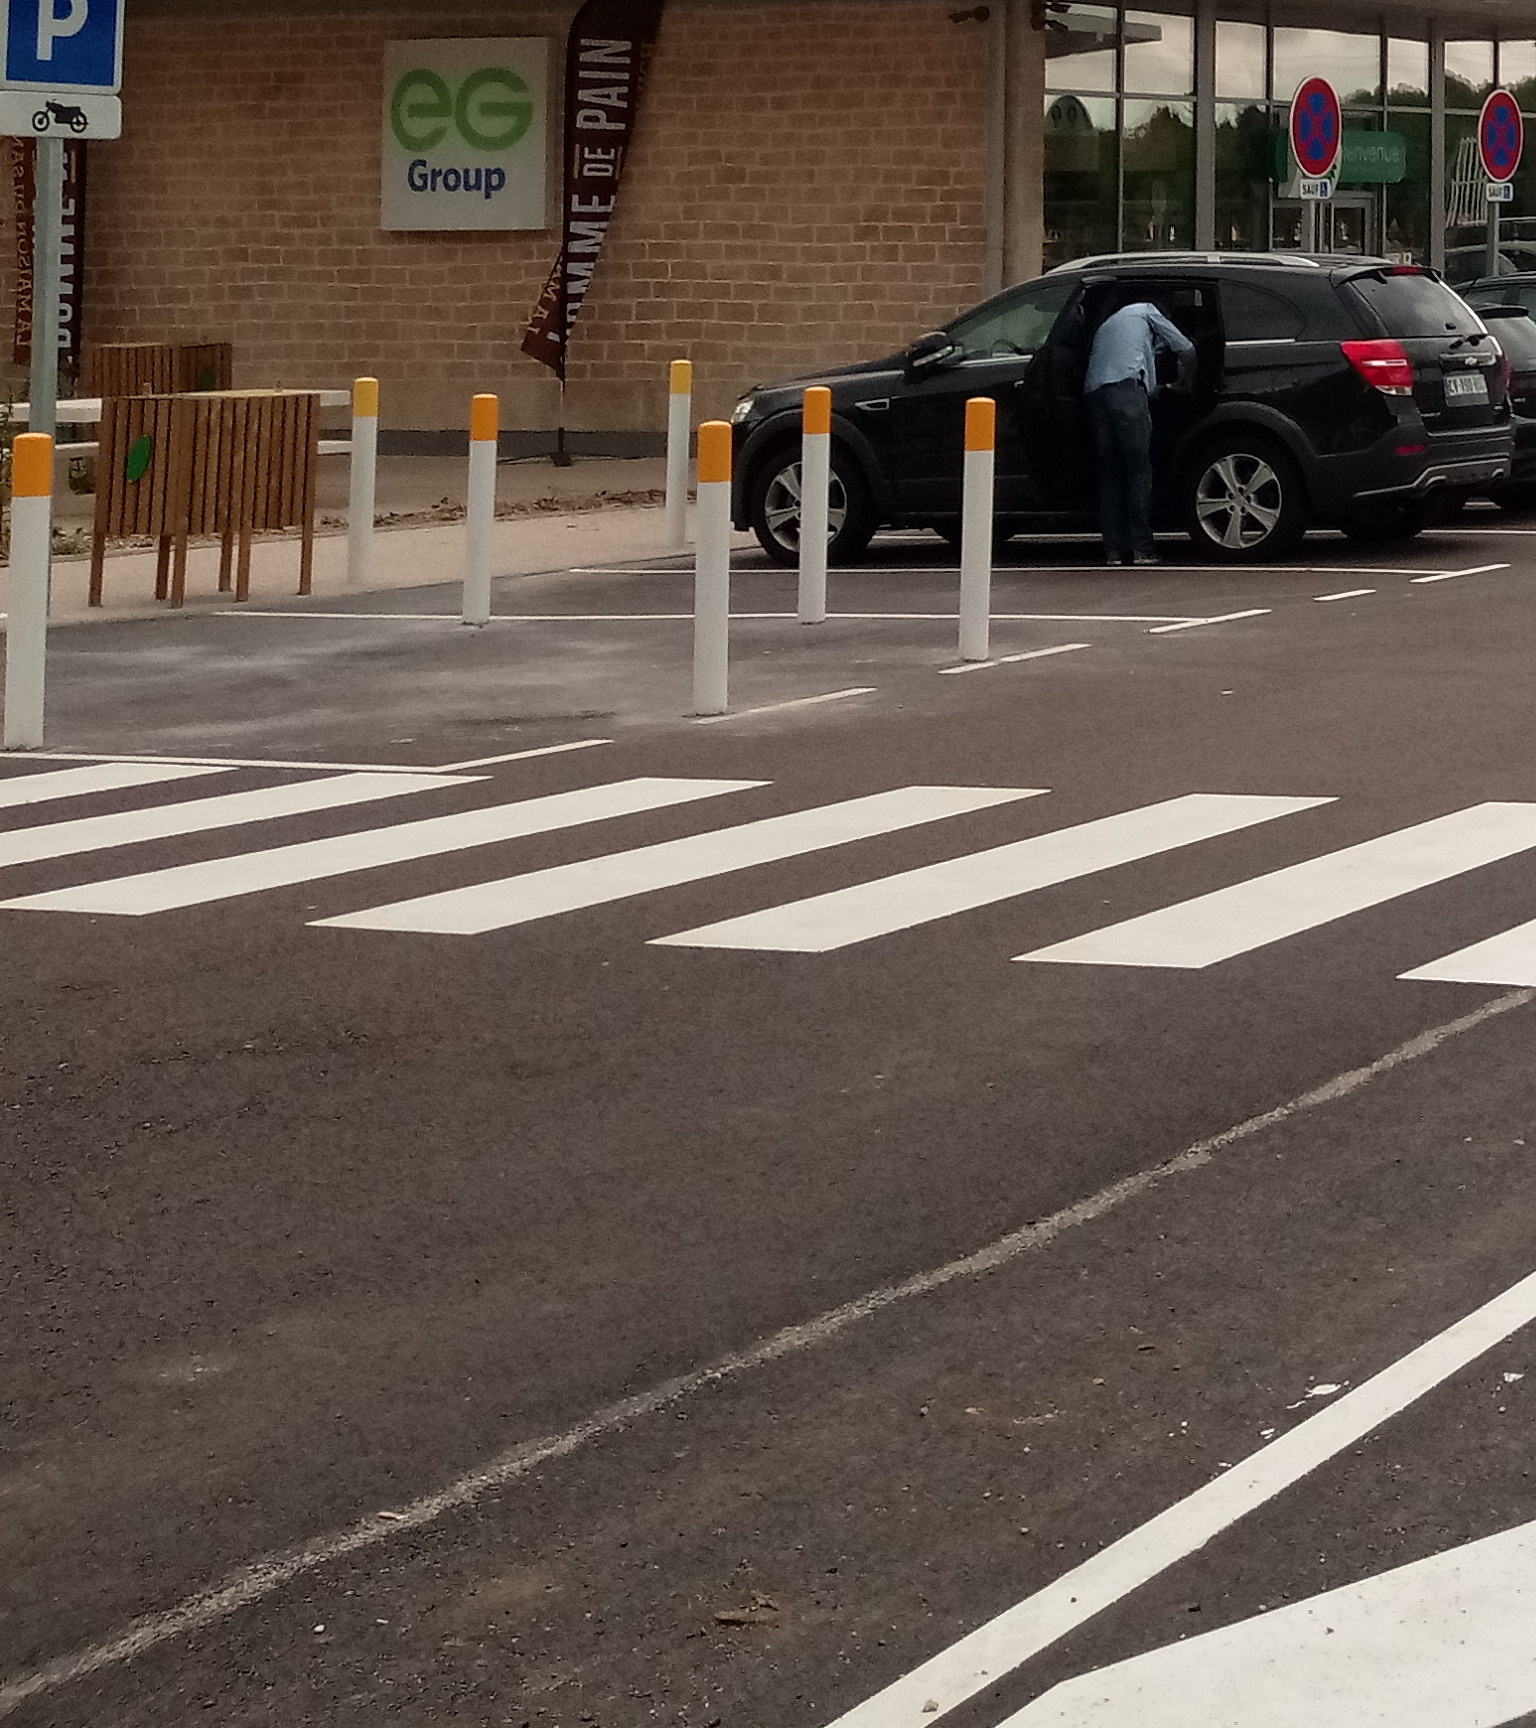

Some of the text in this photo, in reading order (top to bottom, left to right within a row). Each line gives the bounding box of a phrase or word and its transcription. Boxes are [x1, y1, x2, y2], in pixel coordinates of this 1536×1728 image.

[407, 158, 507, 200] Group
[554, 37, 633, 341] OMME DE PAIN
